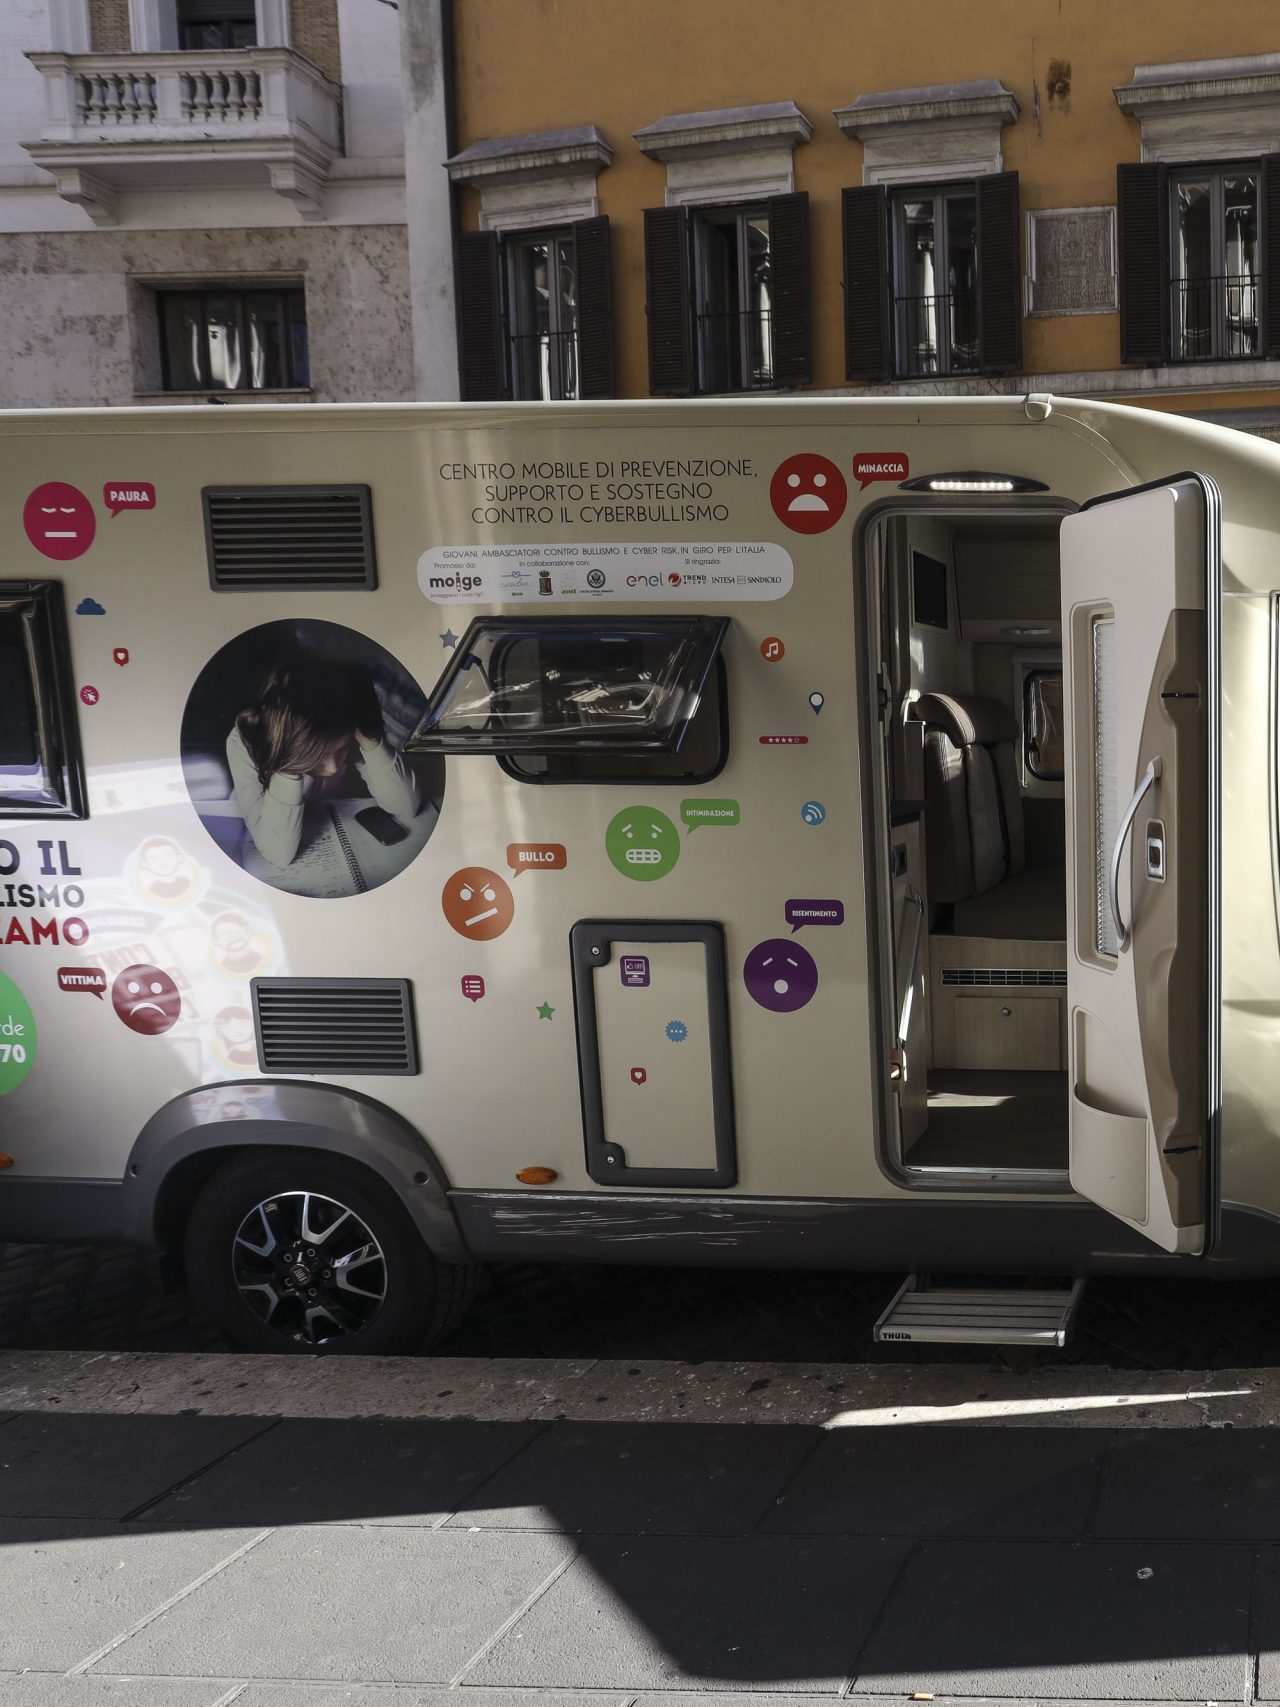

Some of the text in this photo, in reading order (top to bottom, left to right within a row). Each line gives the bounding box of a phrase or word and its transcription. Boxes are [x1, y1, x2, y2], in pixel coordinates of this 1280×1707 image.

[439, 459, 758, 480] CENTRO MOBILE DI PREVENZIONE,
[857, 463, 904, 475] MINACCIA
[110, 490, 150, 502] PAURA
[485, 482, 713, 502] SUPPORTO E SOSTEGNO
[471, 504, 729, 524] CONTRO IL CYBERBULLISMO
[443, 551, 478, 559] GIOVANI
[481, 549, 540, 558] AMBASCIATORI
[544, 548, 579, 556] CONTRO
[582, 547, 620, 556] BULLISMO
[632, 547, 658, 555] CYBER
[680, 547, 689, 555] IN
[693, 546, 714, 554] GIRO
[718, 546, 732, 554] PER
[736, 546, 765, 554] L'ITALIA
[429, 572, 482, 592] moige
[626, 572, 663, 588] enel
[685, 808, 735, 818] INTIMIDAZIONE
[37, 840, 82, 876] IL
[518, 851, 555, 863] BULLO
[0, 884, 85, 908] ISMO
[791, 909, 838, 918] RISENTIMENTO
[0, 916, 90, 947] AMO
[60, 974, 104, 986] VITTIMA
[0, 1014, 25, 1036] de
